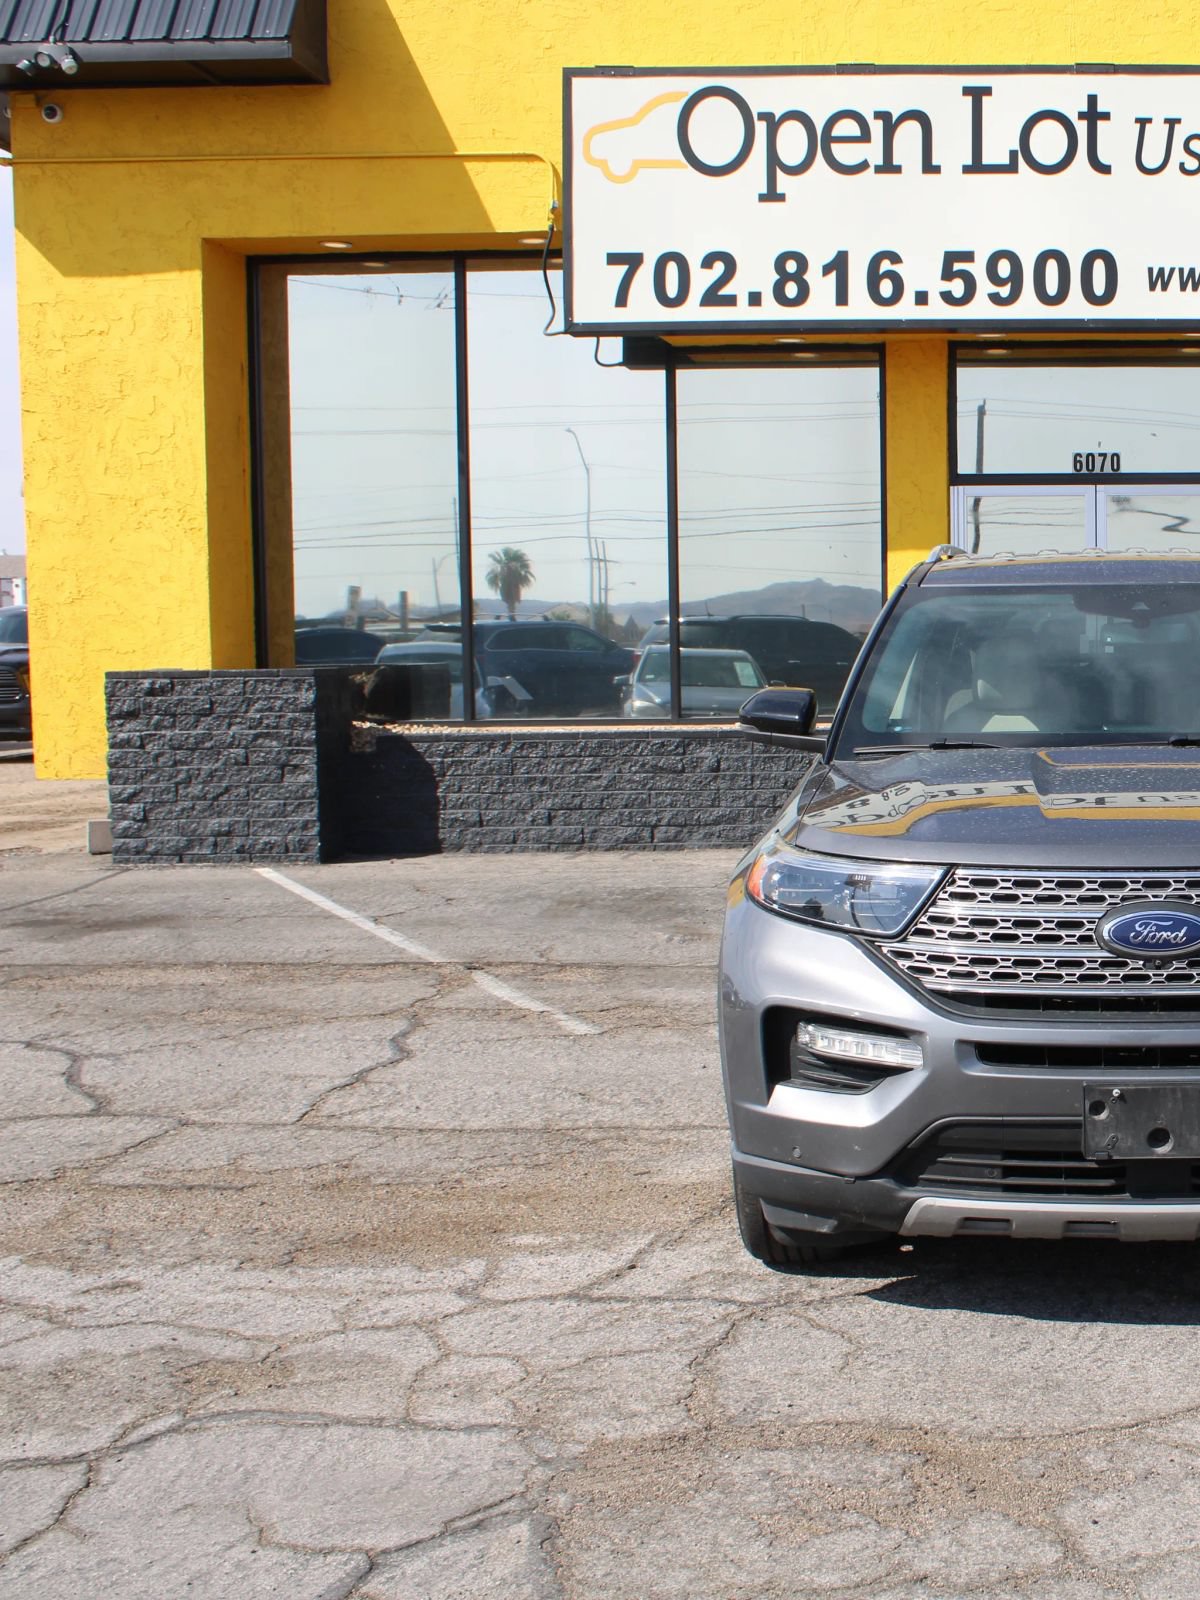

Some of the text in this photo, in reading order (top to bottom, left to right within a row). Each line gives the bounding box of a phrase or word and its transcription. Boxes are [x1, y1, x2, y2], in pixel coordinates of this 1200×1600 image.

[678, 86, 941, 202] Open
[962, 86, 1112, 175] Lot
[606, 249, 1118, 308] 702.816.5900
[1073, 452, 1121, 473] 6070
[1129, 919, 1189, 945] Ford
